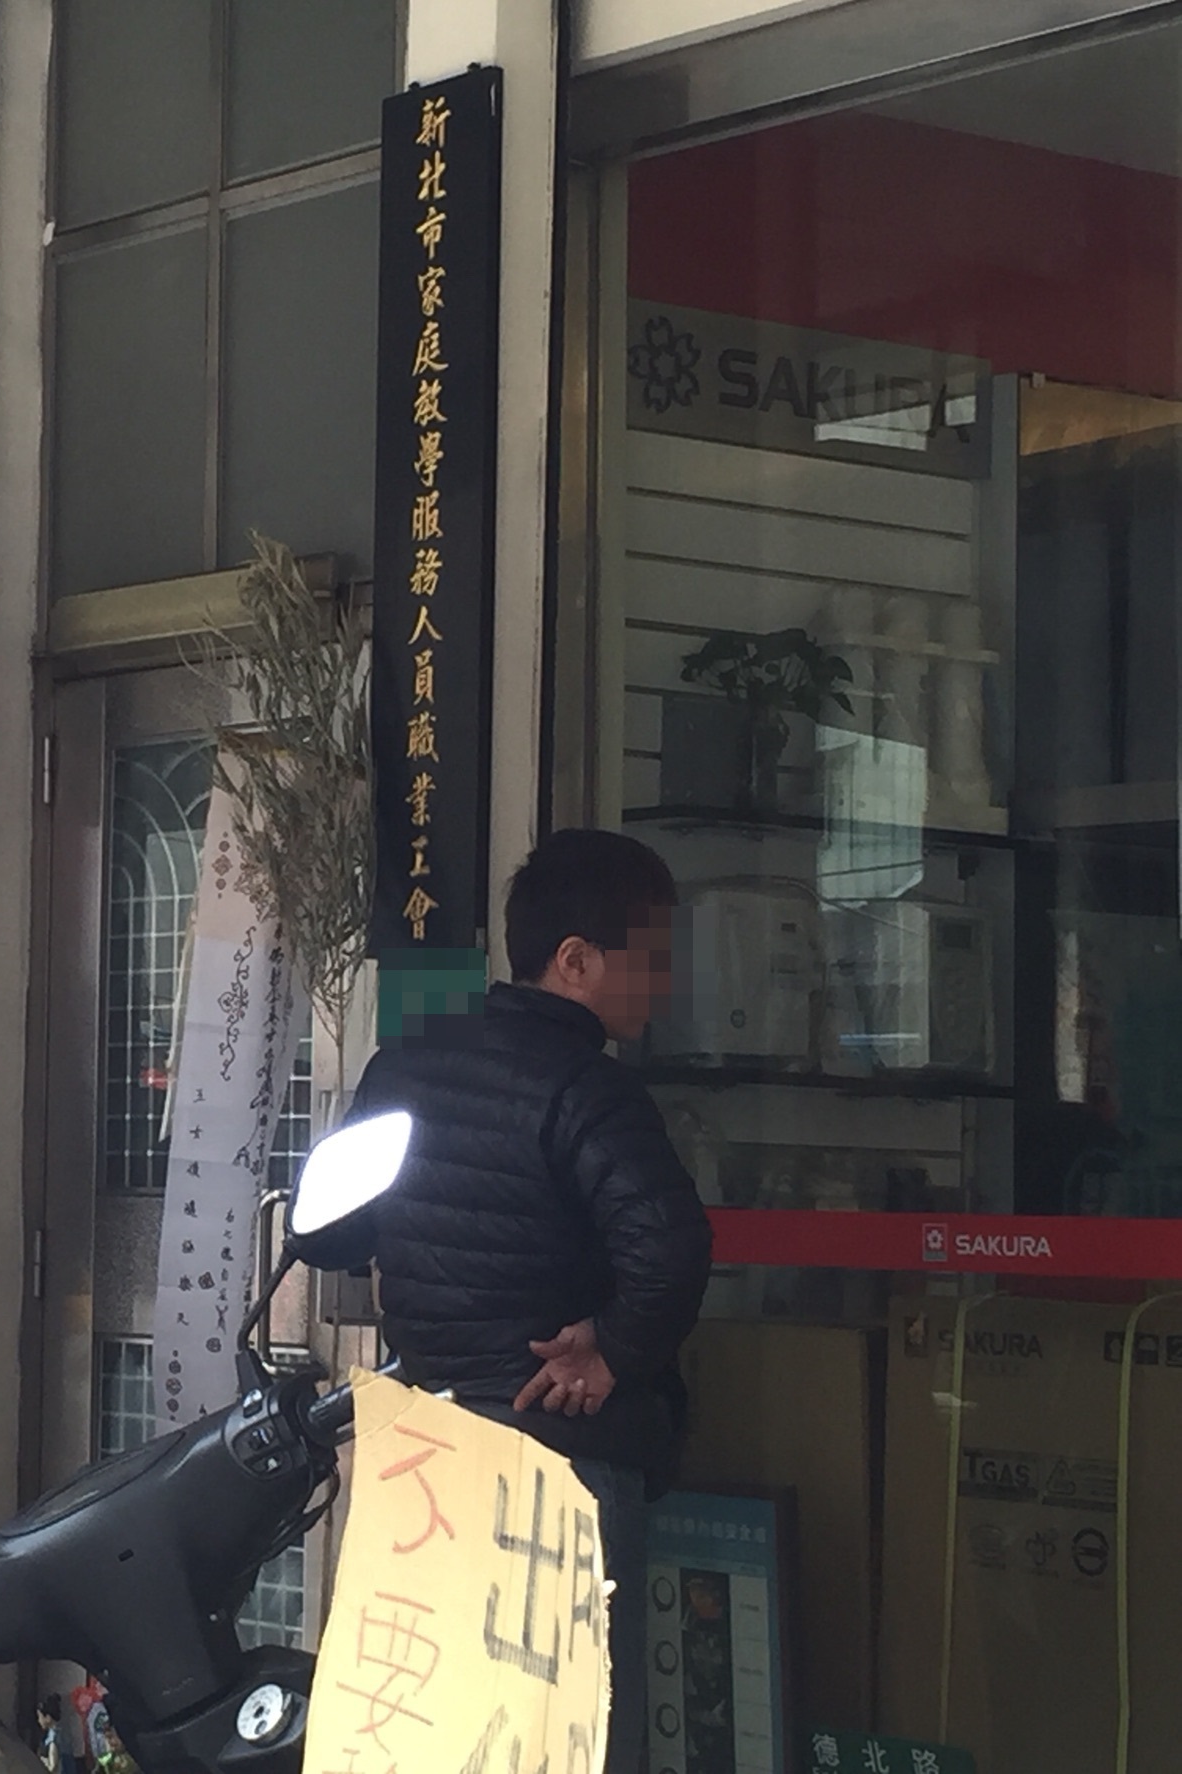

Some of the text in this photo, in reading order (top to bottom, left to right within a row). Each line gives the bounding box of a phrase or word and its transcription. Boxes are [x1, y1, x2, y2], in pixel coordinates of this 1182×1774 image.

[403, 97, 453, 940] 新北市家庭教學服務人員職業工會
[954, 1233, 1053, 1259] SAKURA
[322, 1421, 458, 1774] 不要
